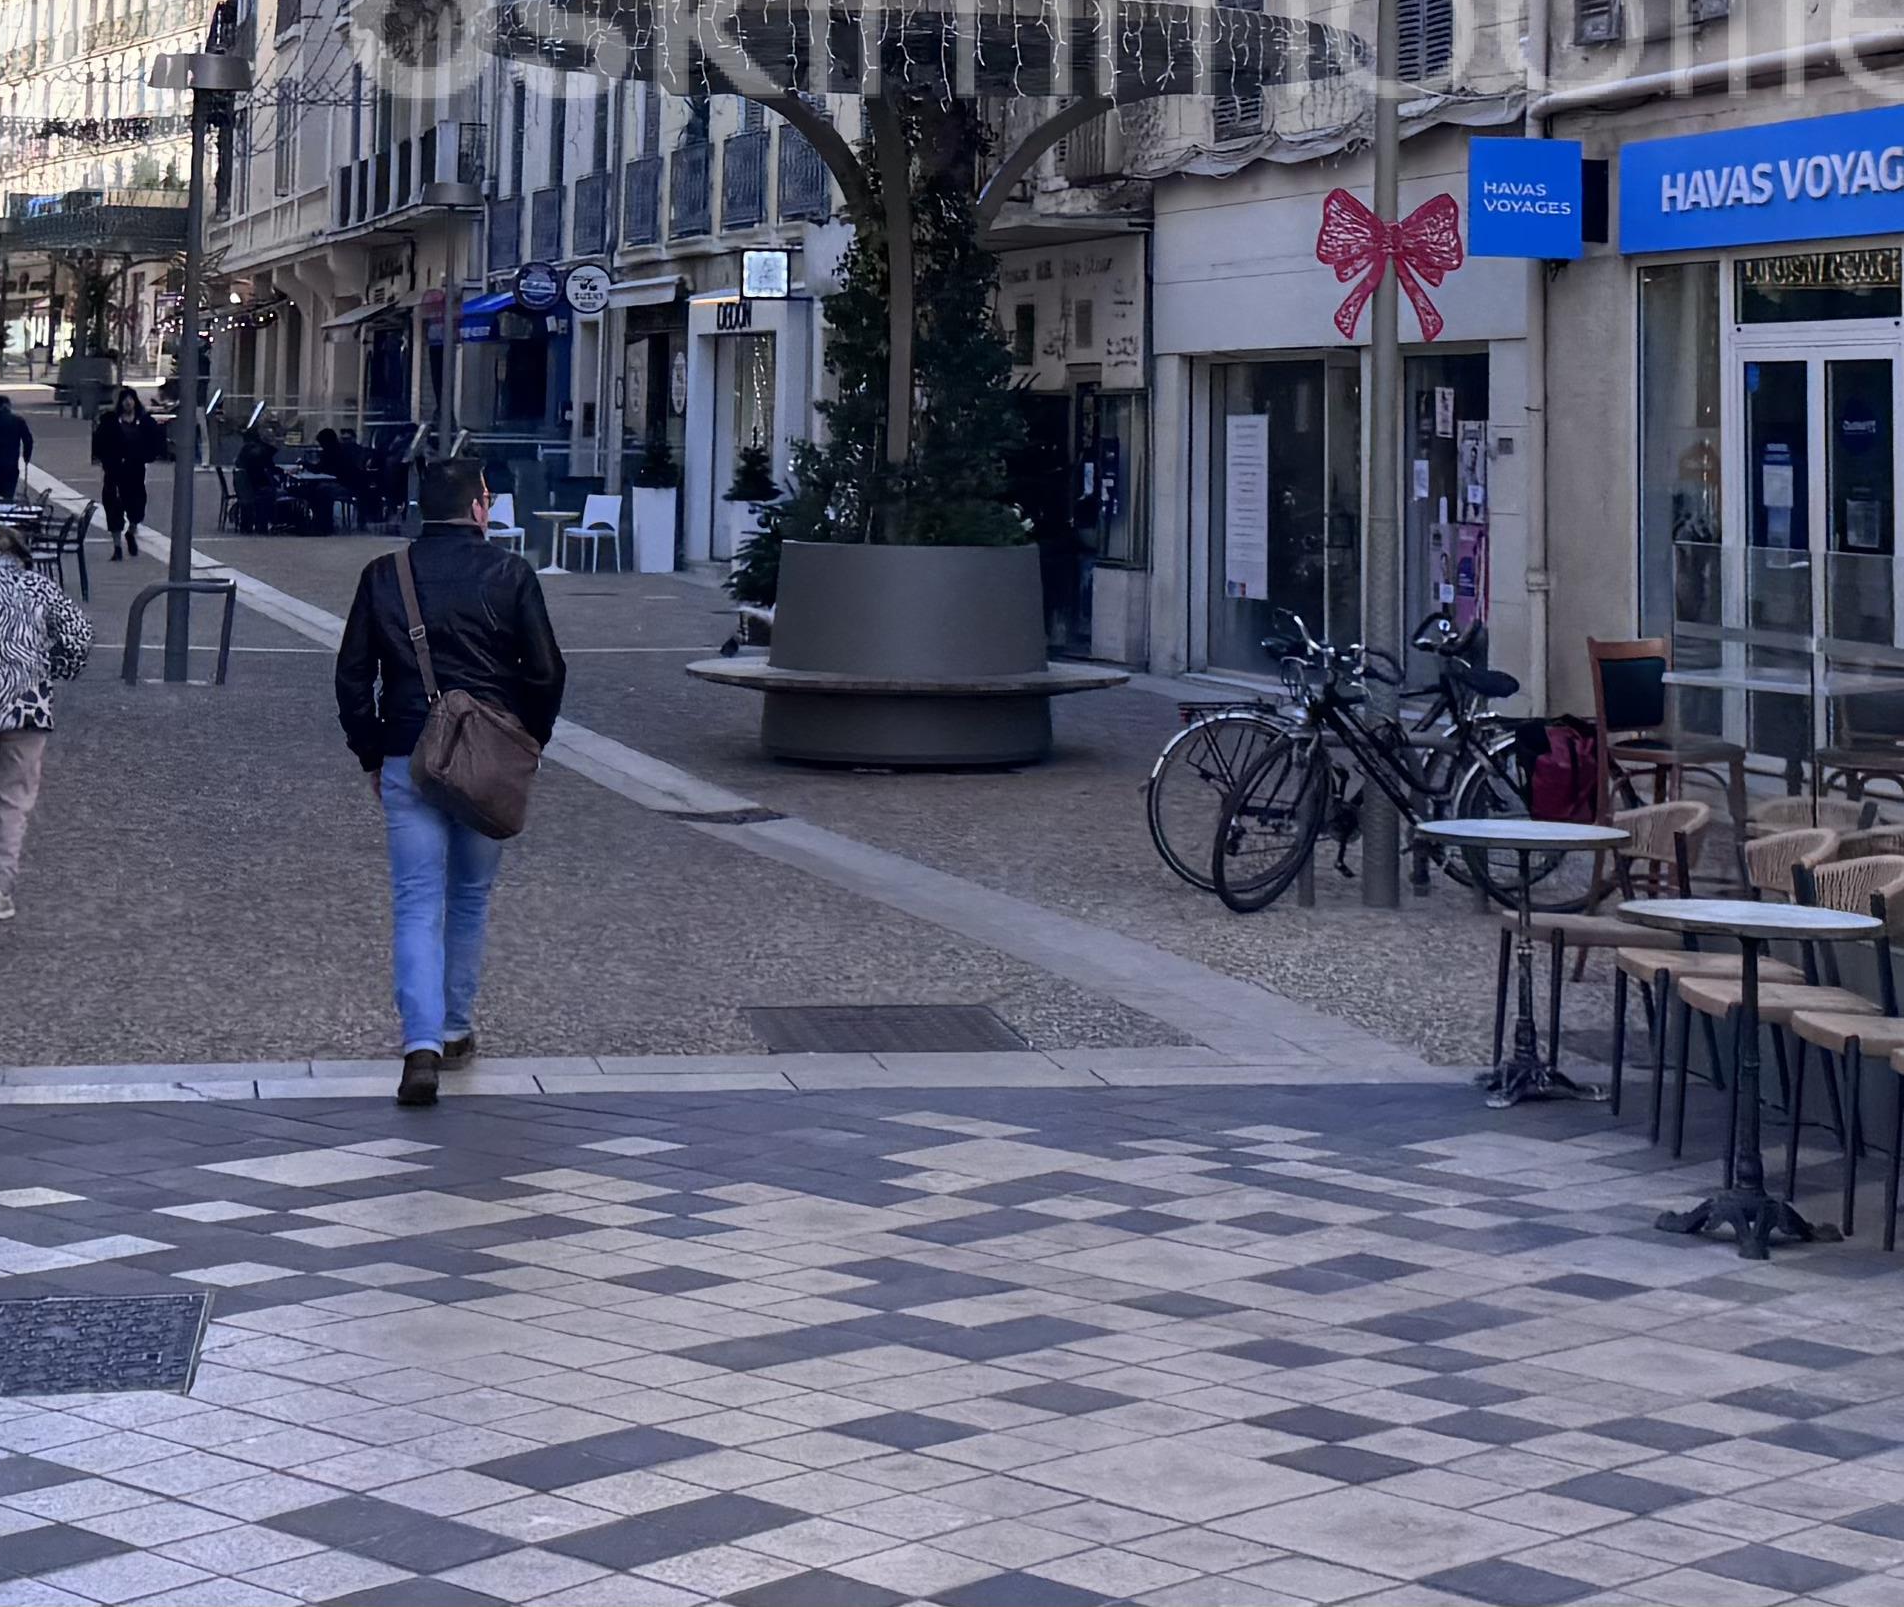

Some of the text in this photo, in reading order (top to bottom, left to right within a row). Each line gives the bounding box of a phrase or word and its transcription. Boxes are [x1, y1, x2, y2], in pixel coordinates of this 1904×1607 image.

[1483, 180, 1548, 197] HAVAS
[1660, 161, 1774, 213] HAVAS
[1483, 198, 1572, 215] VOYAGES
